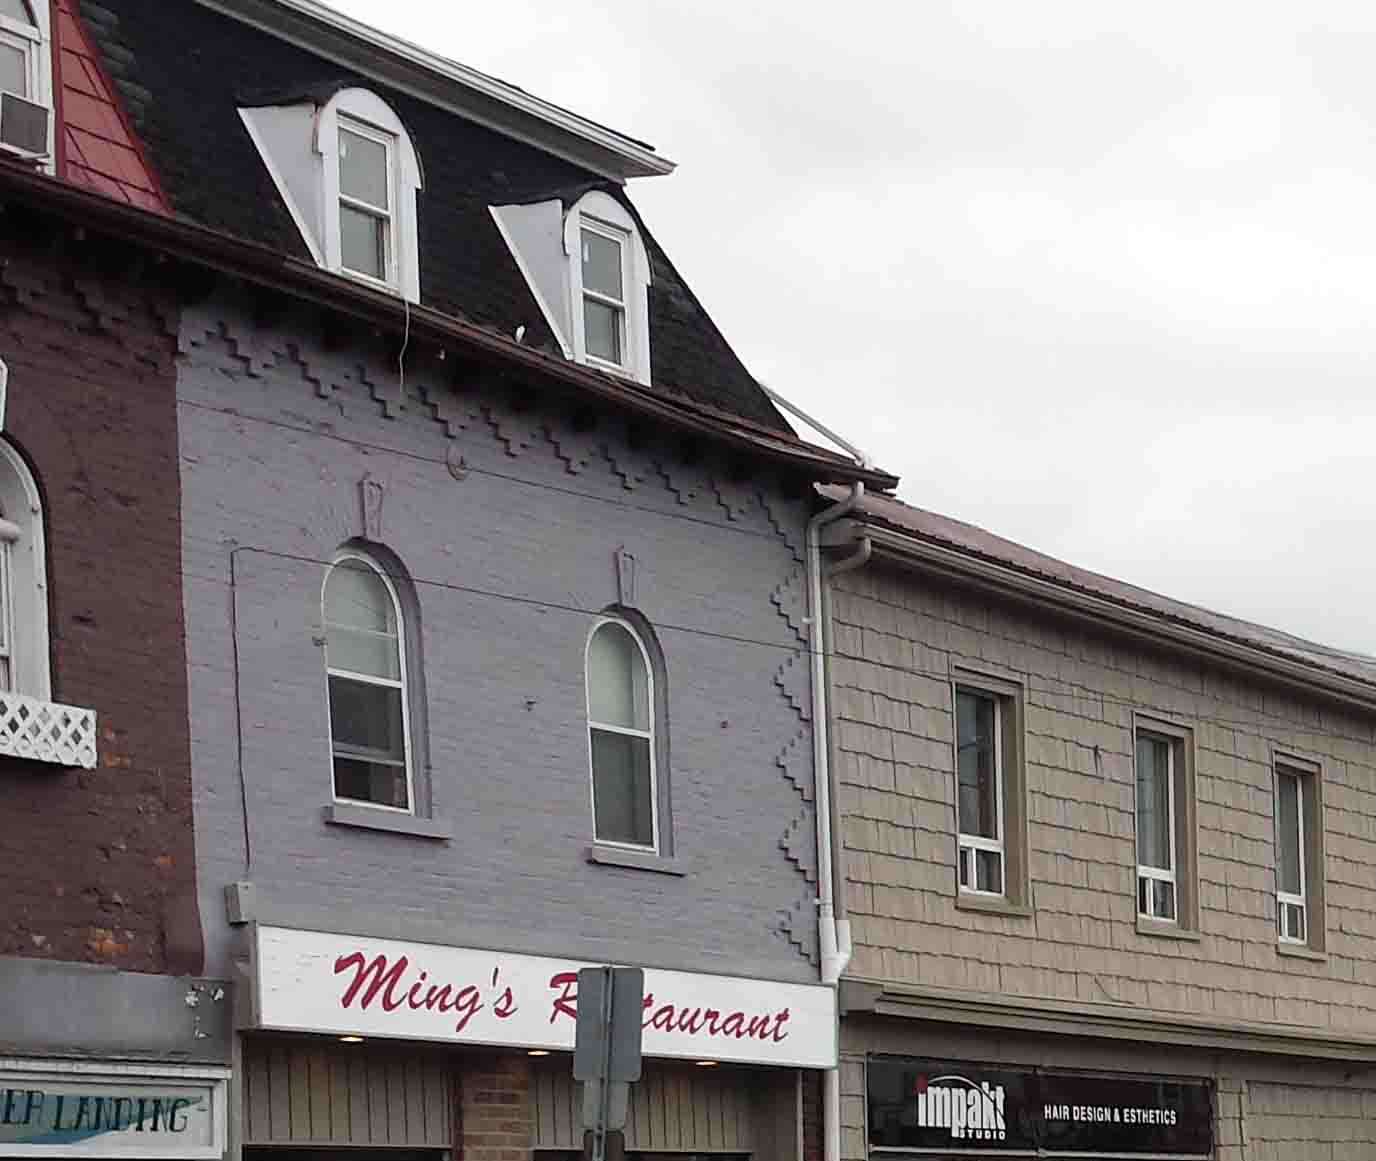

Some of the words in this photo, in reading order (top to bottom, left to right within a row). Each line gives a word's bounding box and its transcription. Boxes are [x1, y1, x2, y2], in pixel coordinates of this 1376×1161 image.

[334, 951, 518, 1032] Ming's
[549, 971, 790, 1042] Rtaurant
[0, 1087, 46, 1125] ER
[53, 1095, 189, 1133] LANDING
[914, 1073, 1006, 1138] impakt
[1044, 1104, 1070, 1121] HAIR
[1072, 1106, 1112, 1123] DESIGN
[1113, 1107, 1121, 1122] &
[1123, 1108, 1177, 1126] ESTHETICS
[959, 1127, 1006, 1140] STUDIO
